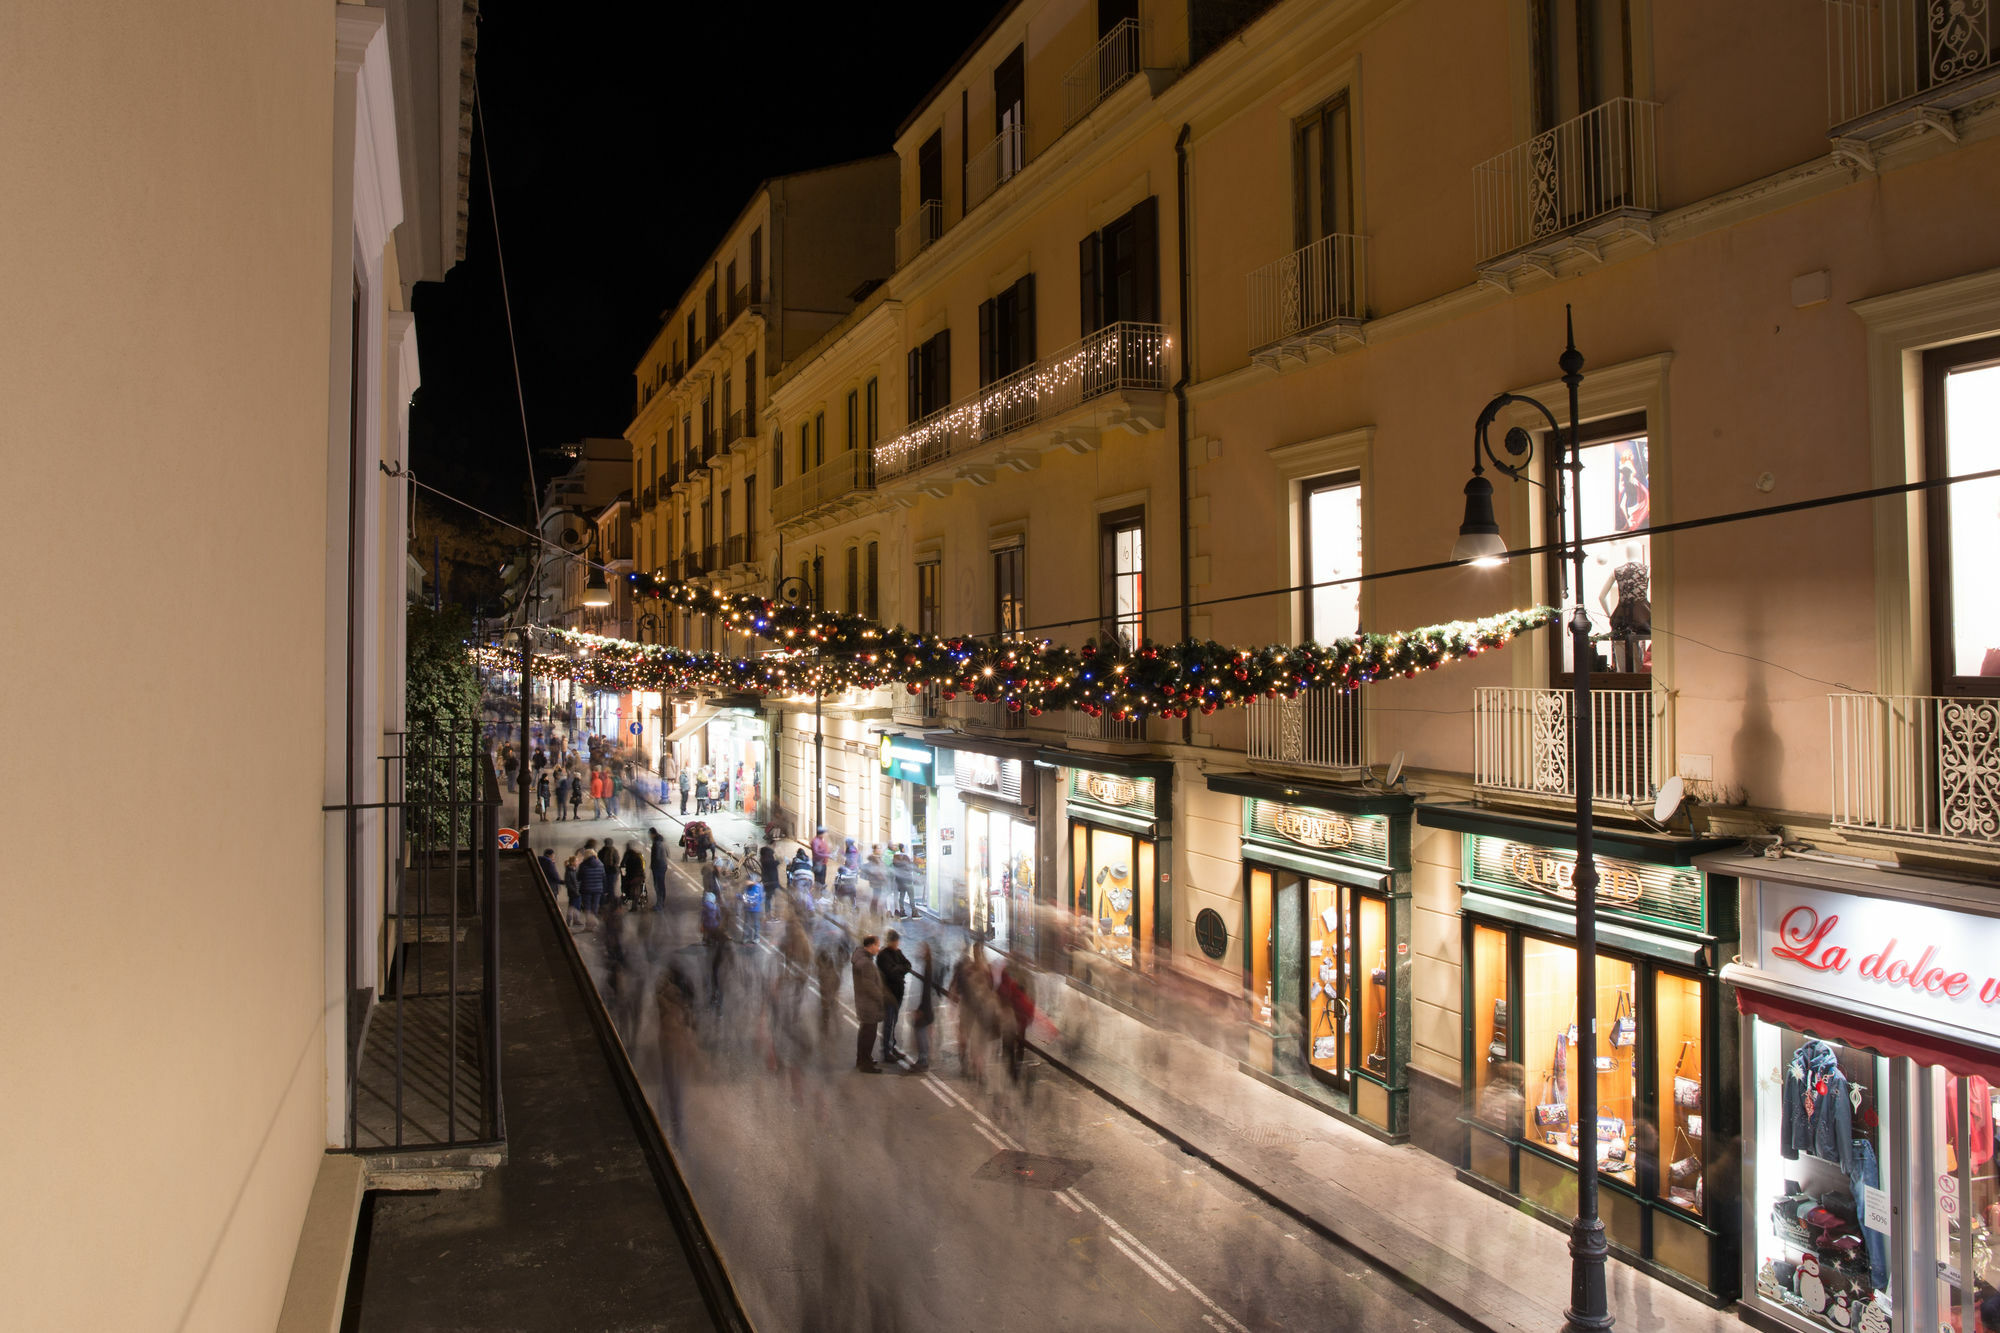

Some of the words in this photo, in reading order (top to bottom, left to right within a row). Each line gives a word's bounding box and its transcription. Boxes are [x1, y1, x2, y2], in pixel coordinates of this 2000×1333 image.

[1278, 811, 1346, 845] APONTE
[1522, 855, 1630, 901] APOTE
[1770, 904, 1851, 973] La
[1858, 937, 1970, 997] dolce
[1868, 1212, 1888, 1227] -50%
